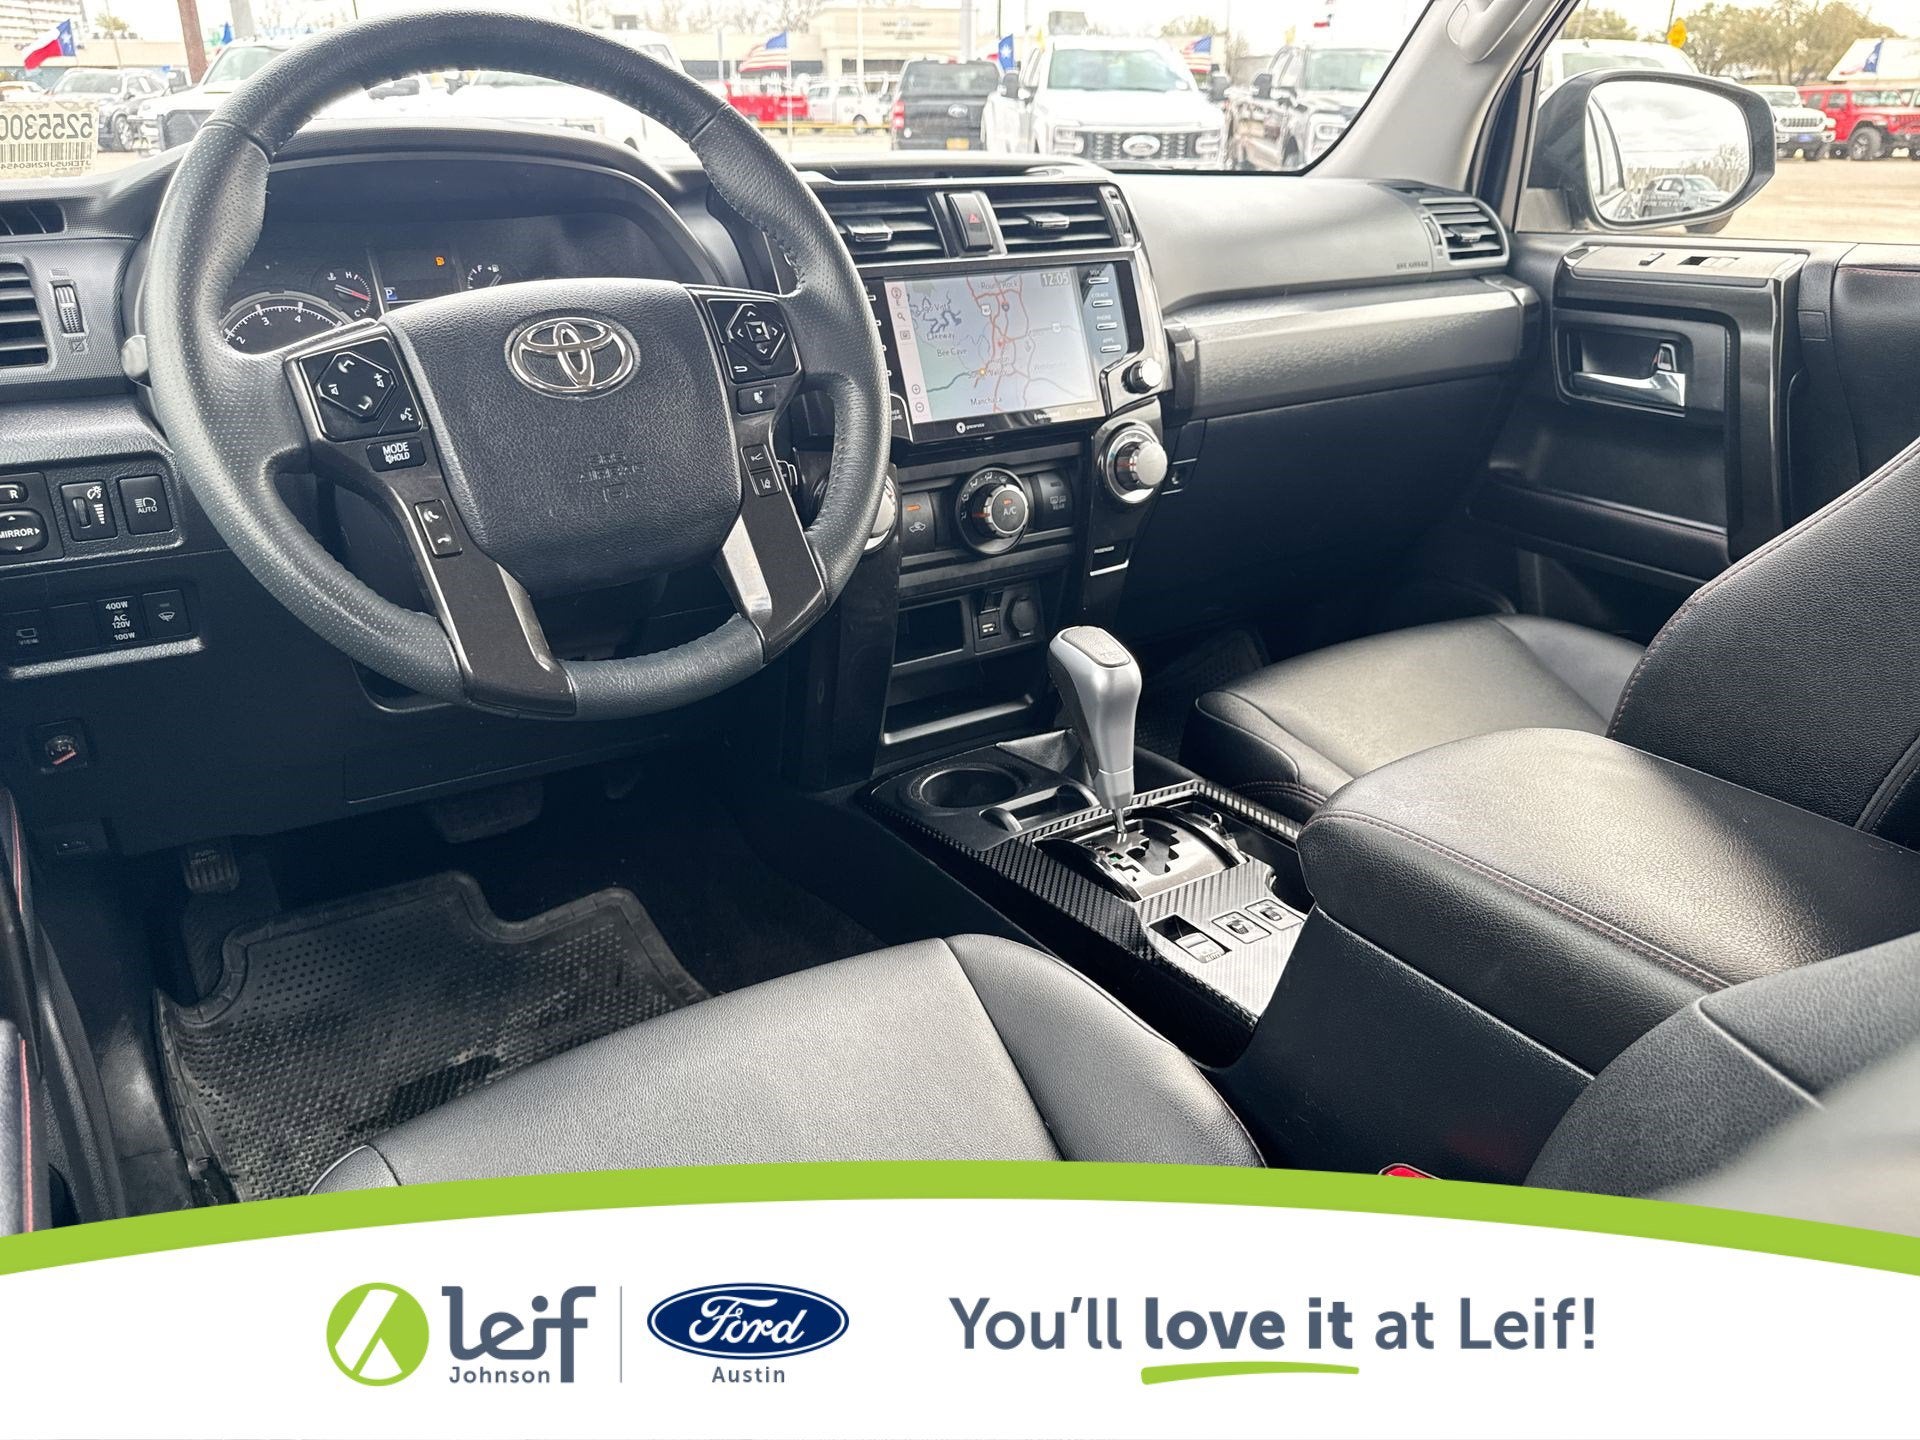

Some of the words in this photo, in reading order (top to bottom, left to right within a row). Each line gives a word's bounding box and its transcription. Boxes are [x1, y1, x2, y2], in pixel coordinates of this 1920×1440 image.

[345, 271, 353, 279] H
[385, 289, 393, 300] P
[354, 309, 361, 317] C
[261, 316, 270, 326] 3
[294, 315, 302, 323] 4
[236, 335, 246, 344] 2
[382, 442, 410, 456] MODE
[391, 452, 410, 462] HOLD
[10, 490, 19, 499] R
[137, 506, 158, 514] AUTO
[1003, 506, 1017, 516] A/C
[0, 528, 34, 539] MIRROR
[105, 601, 128, 611] 400W
[113, 614, 127, 622] AC
[112, 621, 131, 629] 120V
[114, 632, 136, 641] 100W
